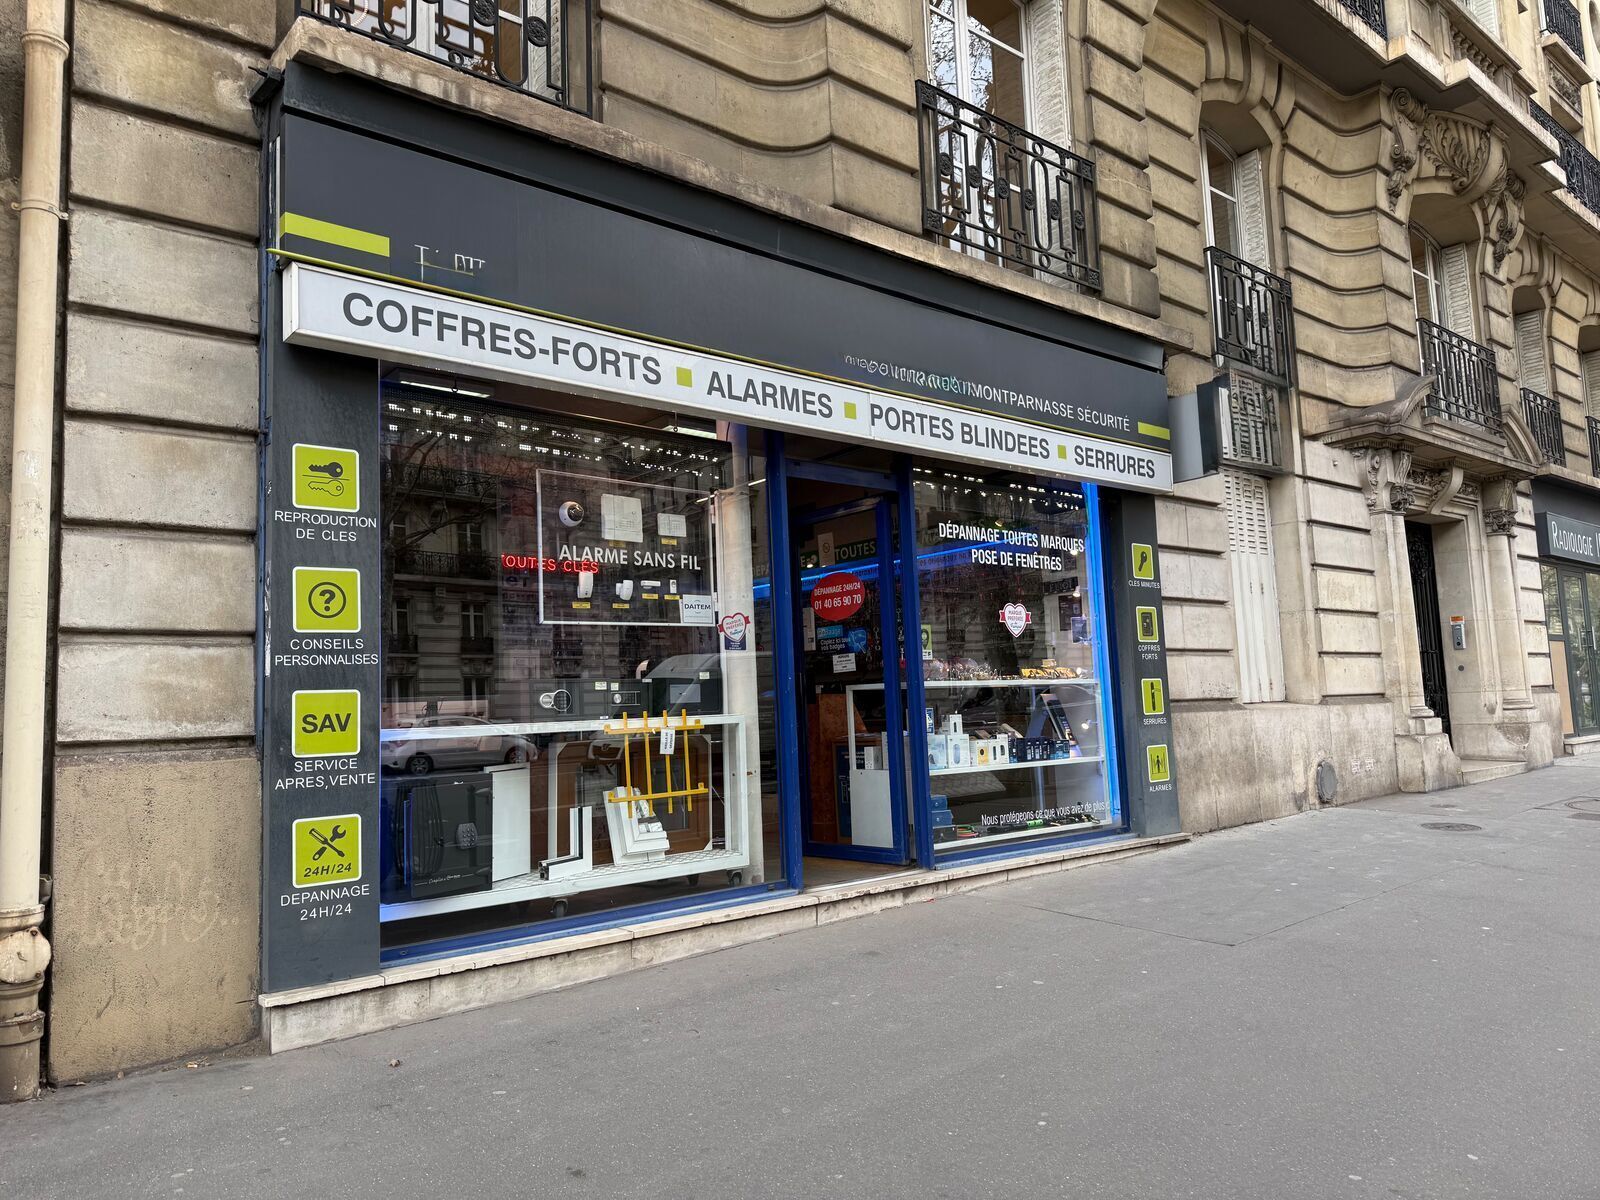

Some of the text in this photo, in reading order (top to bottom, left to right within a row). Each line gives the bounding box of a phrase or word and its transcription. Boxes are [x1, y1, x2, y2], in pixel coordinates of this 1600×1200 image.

[342, 292, 662, 385] COFFRES-FORTS
[706, 370, 834, 419] ALARMES
[870, 402, 955, 442] PORTES
[960, 422, 1051, 461] BLINDEES
[1073, 444, 1156, 480] SERRURES
[971, 383, 1131, 432] MONTPARNASSE SÉCURITÉ
[274, 510, 377, 528] REPRODUCTION
[296, 528, 357, 542] DE CLES
[938, 520, 1000, 543] DÉPANNAGE
[1001, 529, 1039, 548] TOUTES
[1040, 534, 1085, 553] MARQUES
[558, 544, 701, 571] ALARME SANS FIL
[563, 559, 599, 573] CLÉS
[971, 549, 998, 565] POSE
[1000, 553, 1014, 567] DE
[1016, 551, 1062, 571] FENÊTRES
[814, 600, 822, 610] 01
[824, 598, 832, 609] 40
[833, 597, 842, 608] 65
[852, 593, 862, 605] 70
[290, 638, 364, 650] CONSEILS
[1138, 644, 1160, 652] COFFRES
[275, 654, 379, 666] PERSONNALISES
[301, 712, 352, 734] SAV
[1143, 717, 1167, 726] SERRURES
[294, 758, 358, 773] SERVICE
[274, 772, 376, 791] APRES,VENTE
[1149, 783, 1172, 792] ALARMES
[981, 813, 999, 826] Nous
[1000, 809, 1035, 824] protégeons
[1035, 810, 1045, 819] ce
[1056, 805, 1071, 816] vous
[1071, 804, 1084, 814] avez
[1084, 800, 1093, 812] de
[1093, 799, 1106, 814] plus
[303, 862, 352, 878] 24H/24
[280, 884, 370, 907] DEPANNAGE
[300, 902, 352, 921] 24H/24
